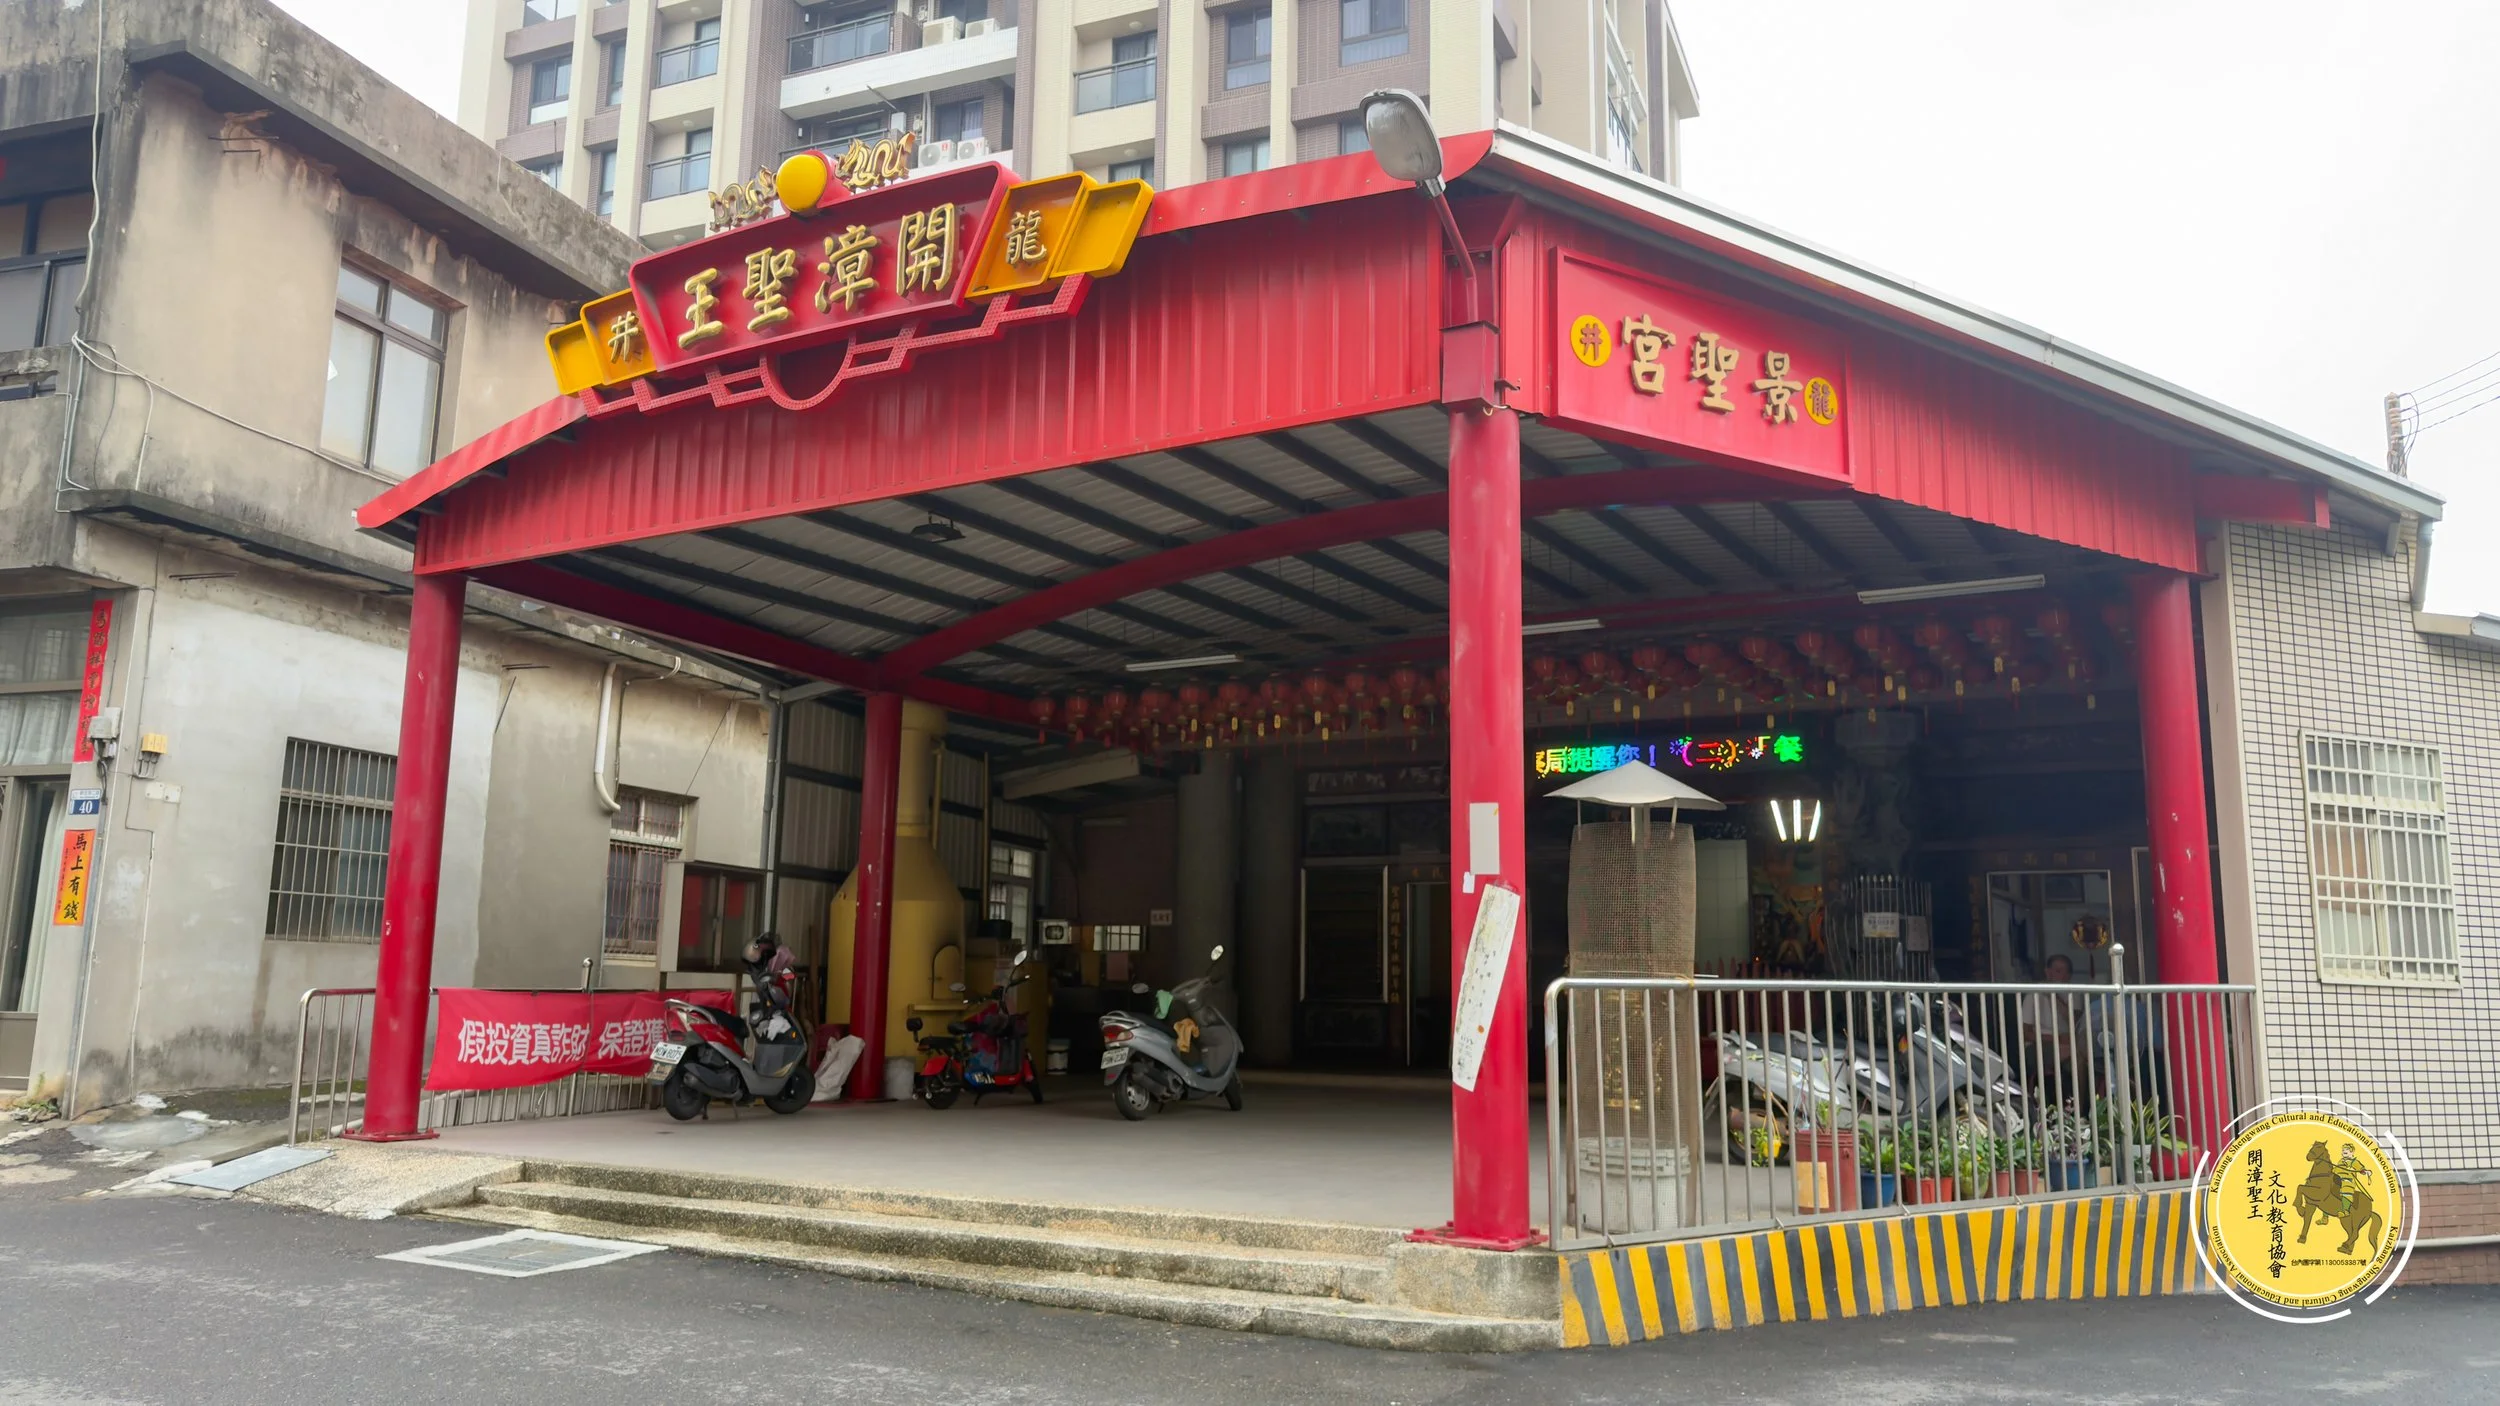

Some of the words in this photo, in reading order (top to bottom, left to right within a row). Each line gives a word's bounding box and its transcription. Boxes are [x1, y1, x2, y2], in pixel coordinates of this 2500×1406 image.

[1005, 210, 1048, 266] 龍
[606, 311, 643, 363] 井
[1580, 323, 1603, 361] 井
[1811, 381, 1837, 420] 龍
[79, 800, 93, 814] 40
[64, 833, 87, 921] 馬上有錢
[457, 1018, 590, 1065] 假投資真詐財
